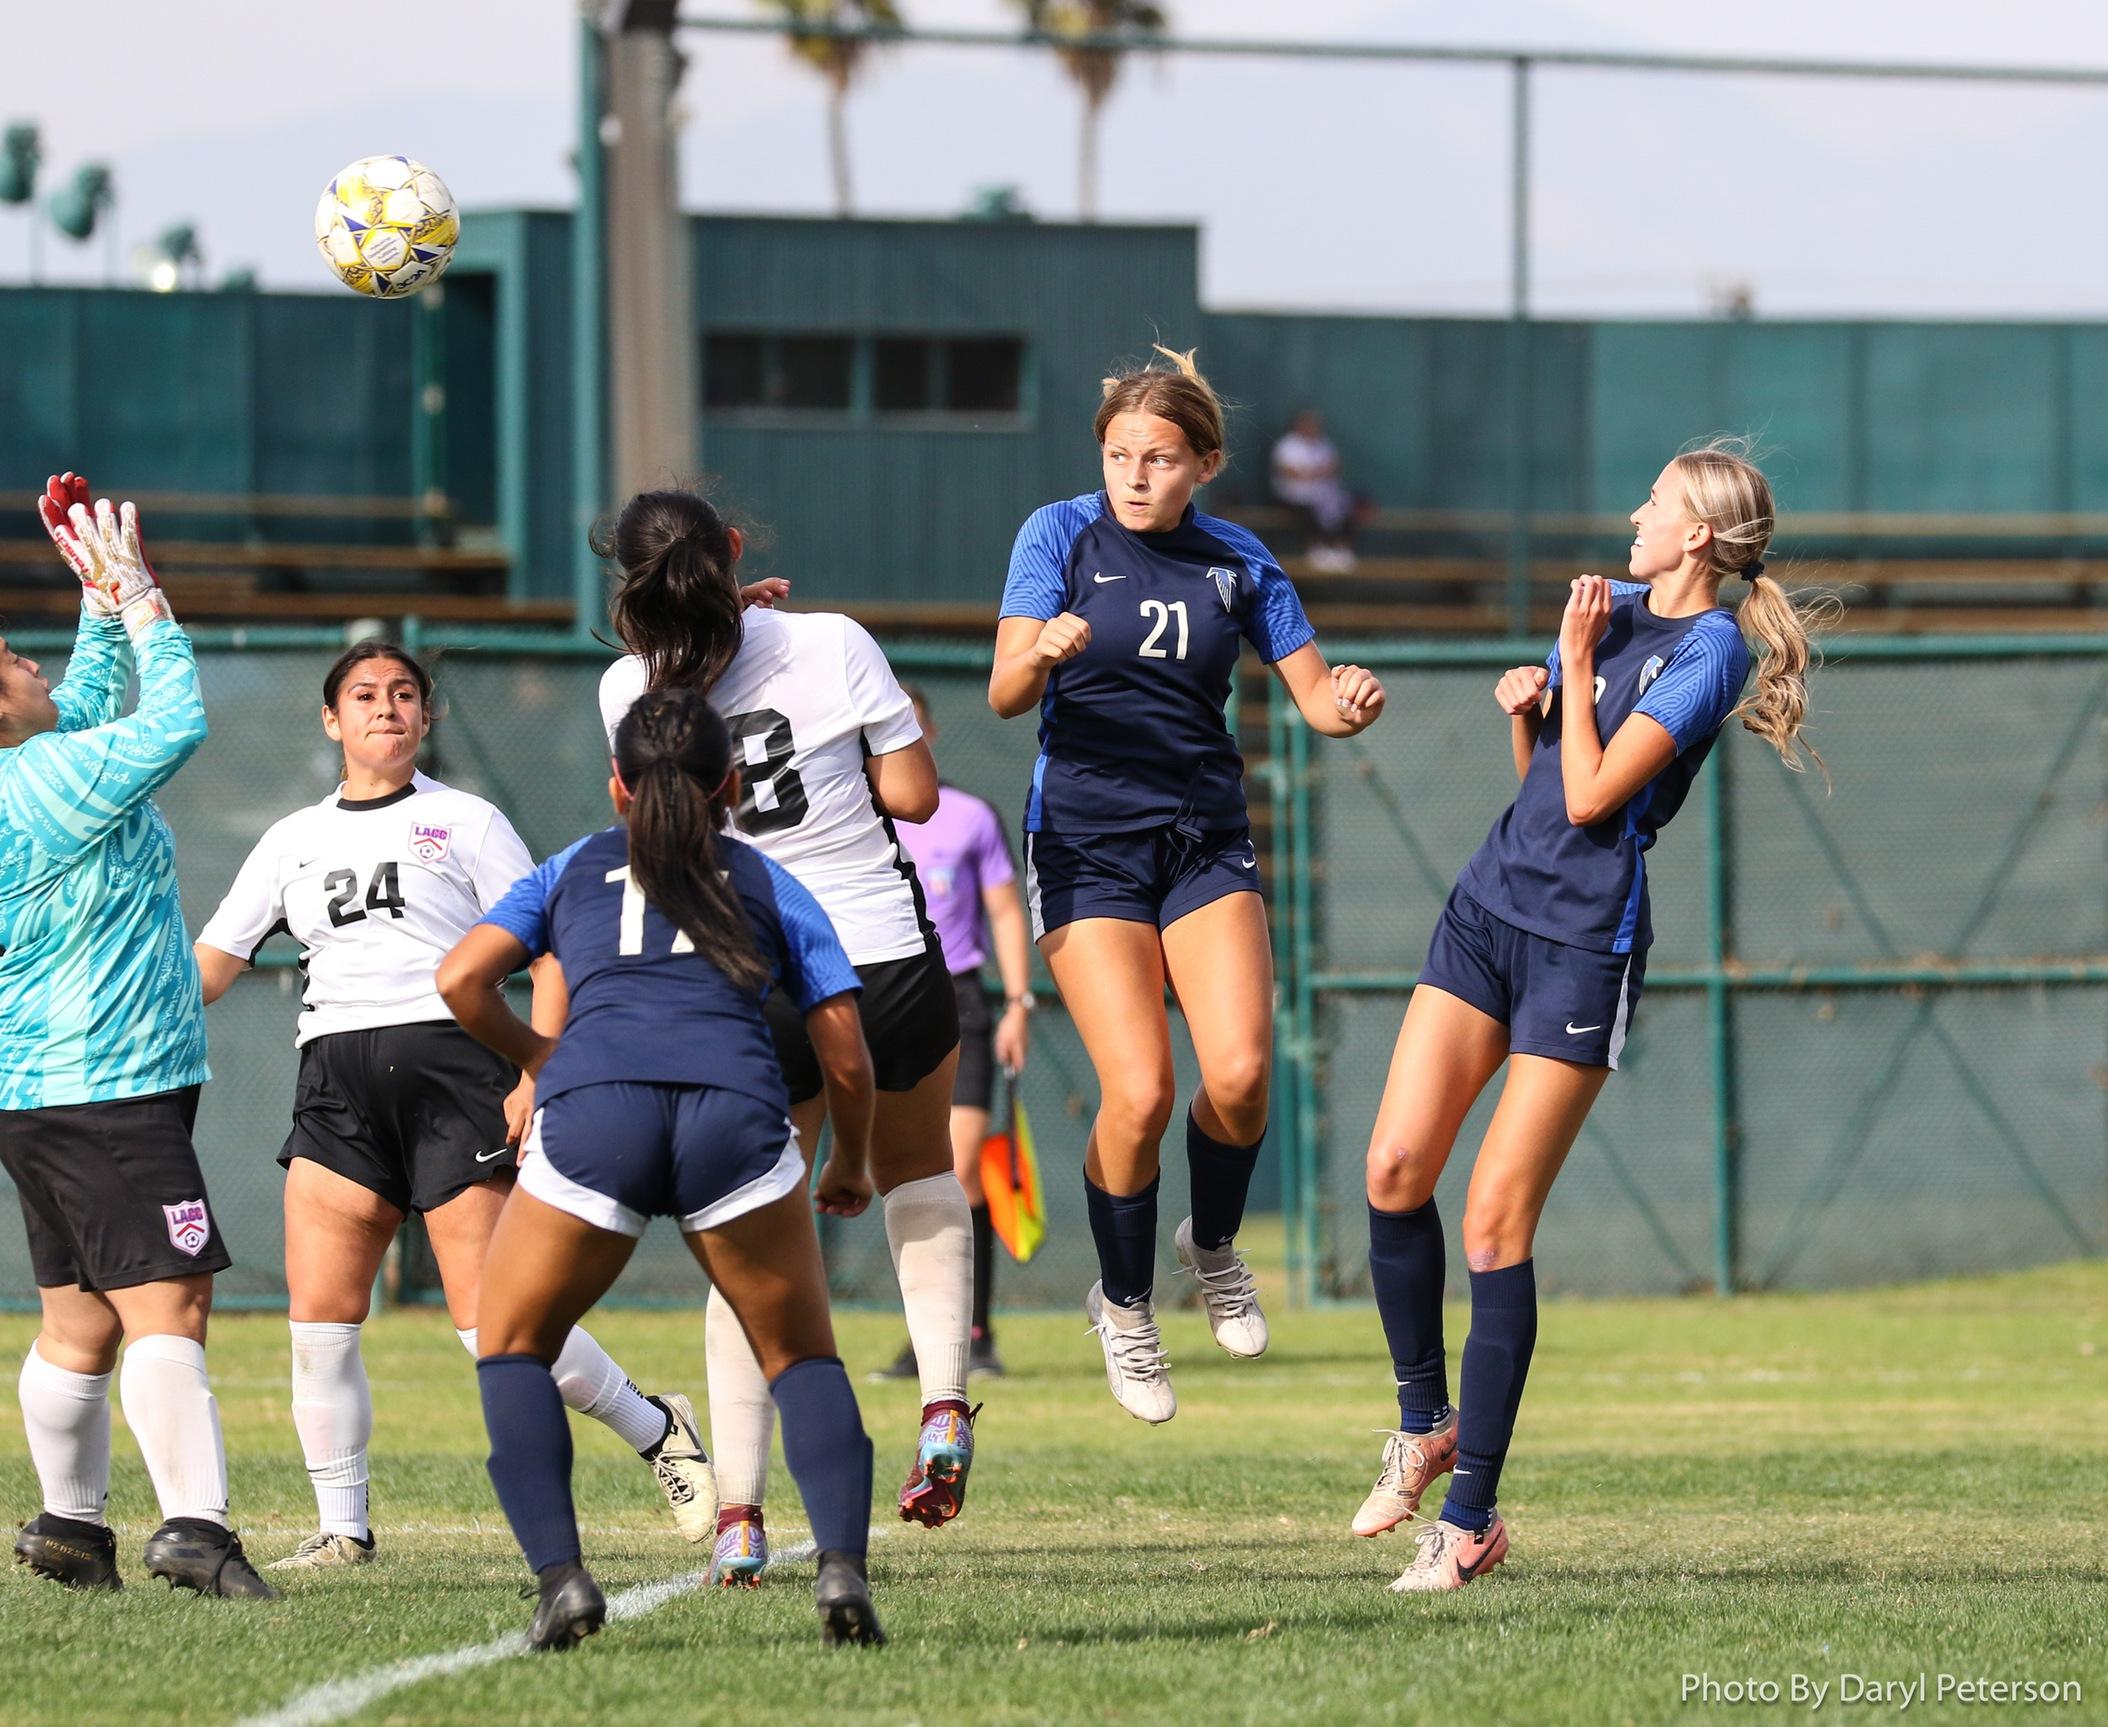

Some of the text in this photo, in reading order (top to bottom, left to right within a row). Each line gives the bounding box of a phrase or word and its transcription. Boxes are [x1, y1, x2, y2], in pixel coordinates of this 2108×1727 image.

[1138, 599, 1189, 660] 21
[720, 707, 810, 838] 8
[323, 861, 406, 928] 24
